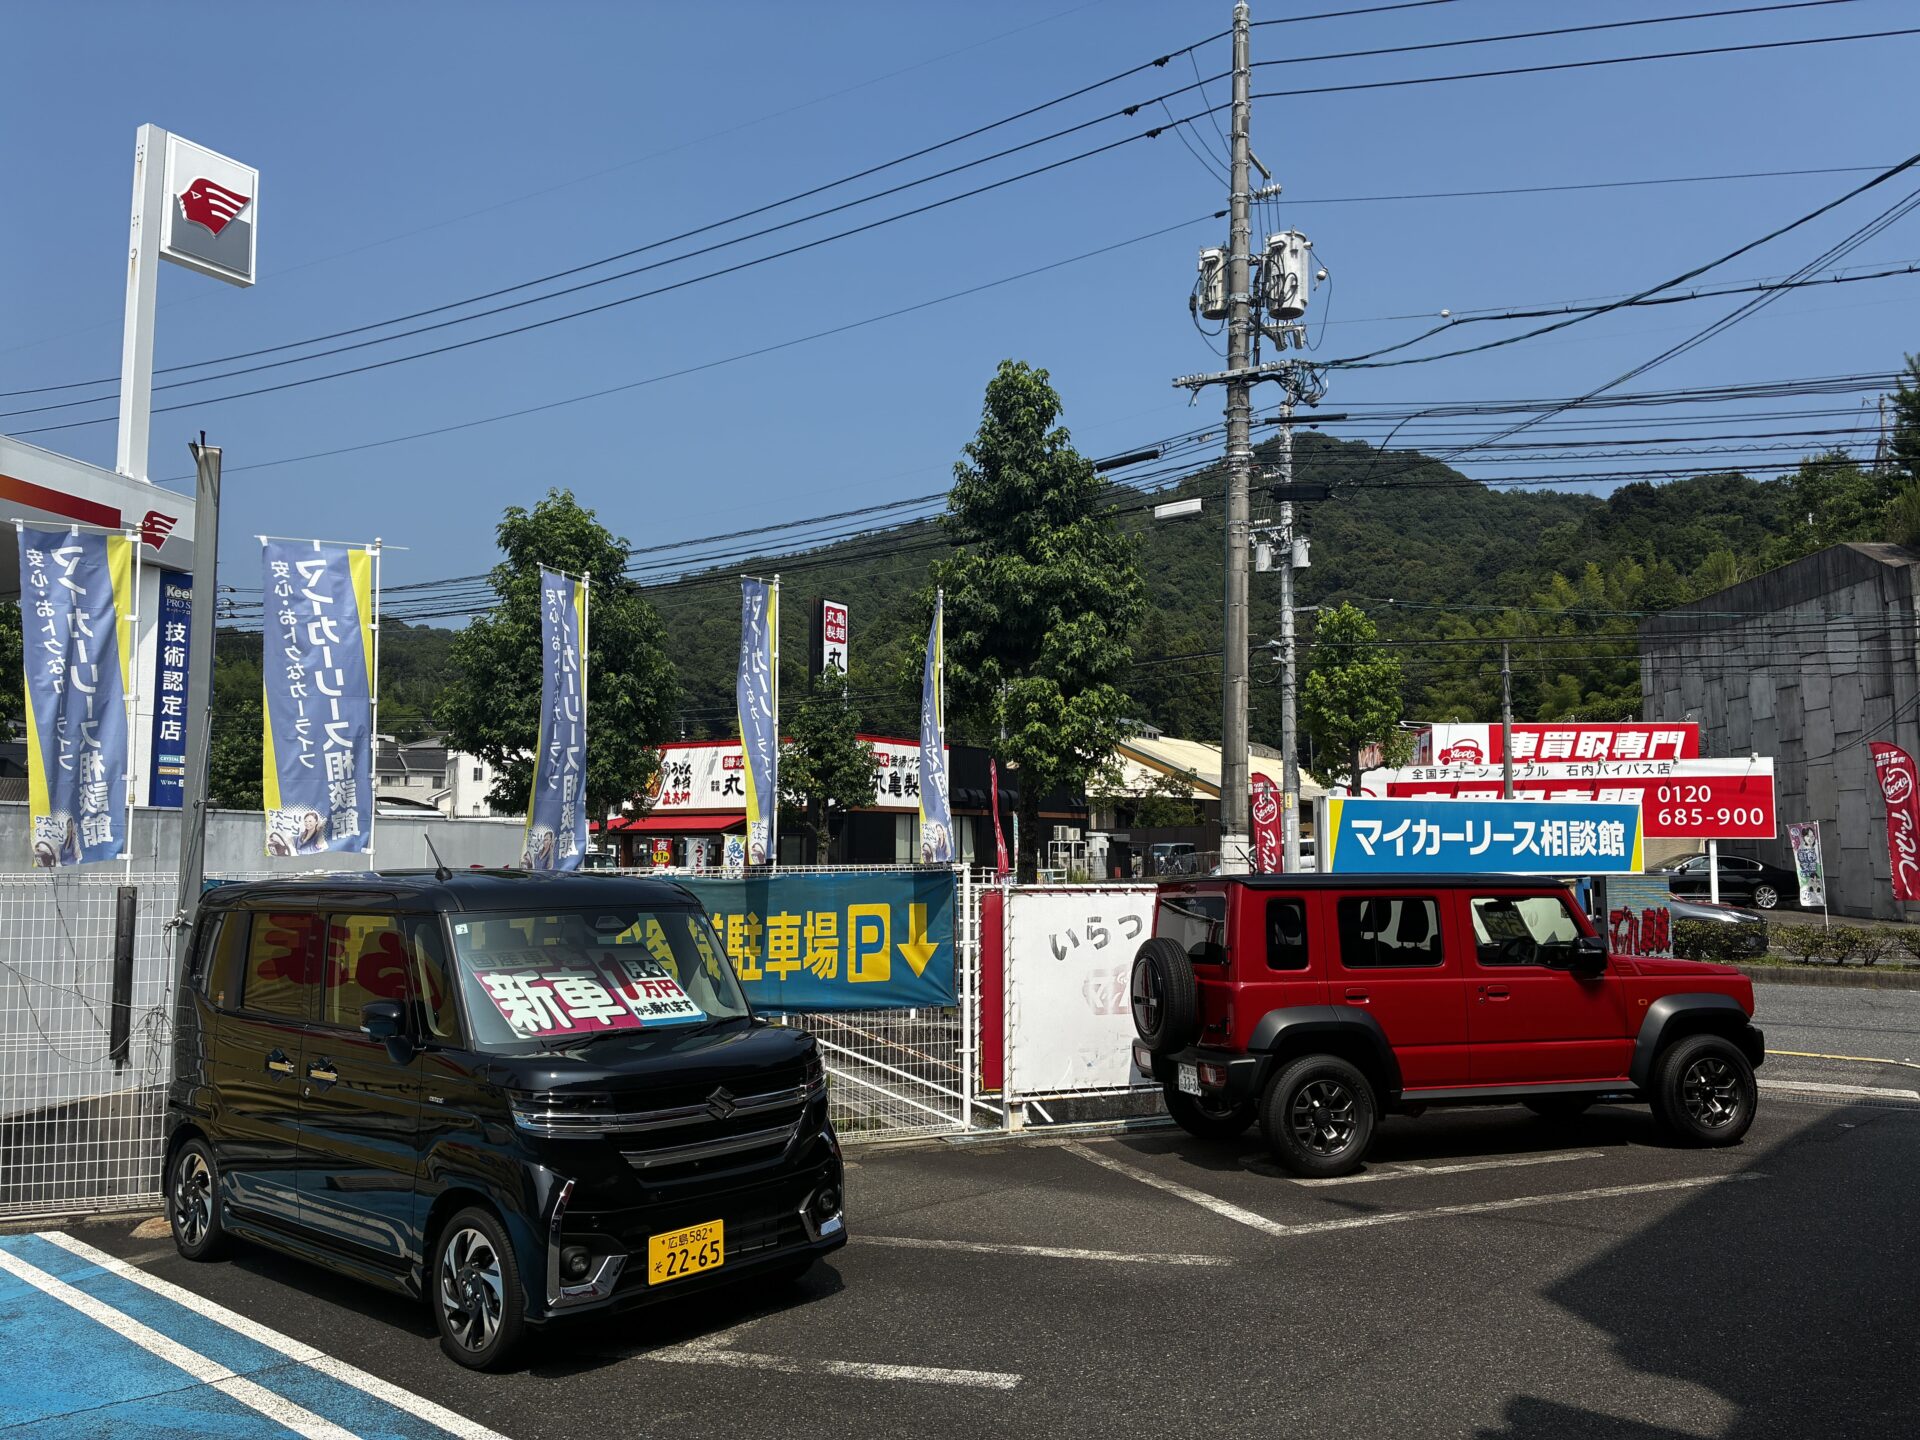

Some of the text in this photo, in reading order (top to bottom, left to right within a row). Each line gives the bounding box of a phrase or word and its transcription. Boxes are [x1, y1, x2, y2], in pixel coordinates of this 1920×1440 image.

[160, 621, 186, 741] 技術認定店
[1510, 731, 1686, 759] 車買取専門
[671, 762, 693, 776] うどん
[672, 776, 691, 789] 弁当
[663, 790, 691, 805] 直売所
[1657, 785, 1711, 803] 0120
[1658, 807, 1764, 826] 685-900
[1351, 818, 1625, 857] マイカーリース相談館
[481, 966, 629, 1033] 新車
[634, 1000, 694, 1015] から乗れます
[668, 1227, 708, 1250] 広島 582
[666, 1239, 720, 1277] 22-65
